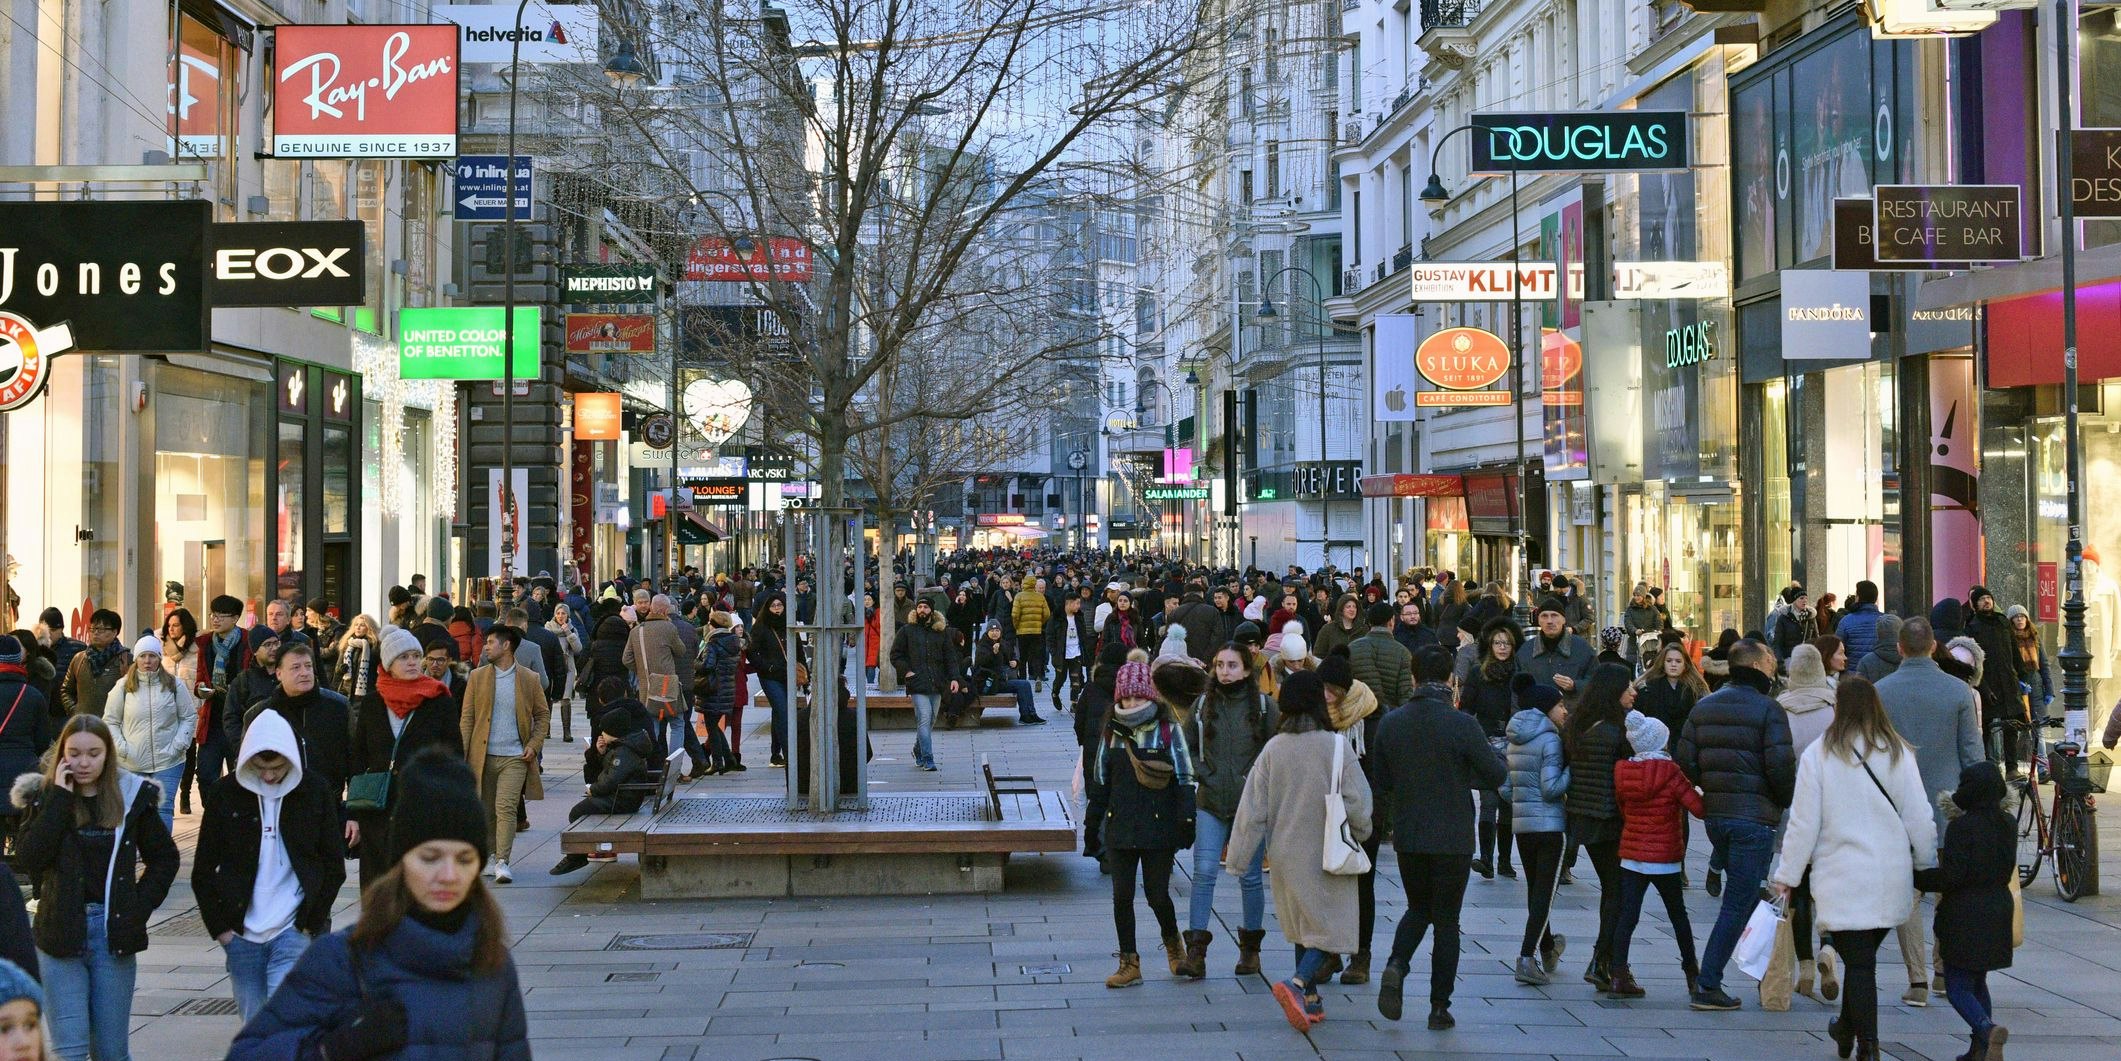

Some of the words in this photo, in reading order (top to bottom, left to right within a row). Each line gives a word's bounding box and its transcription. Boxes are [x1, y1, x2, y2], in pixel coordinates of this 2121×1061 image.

[280, 143, 351, 153] GENUINE
[359, 143, 407, 153] SINCE
[414, 143, 451, 153] 1937
[1489, 123, 1668, 161] DOUGLAS
[1882, 200, 2014, 218] RESTAURANT
[1894, 227, 1947, 245] CAFE
[1963, 227, 2004, 245] BAR
[211, 247, 351, 280] EOX
[0, 248, 176, 306] Jones
[567, 277, 636, 291] MEPHISTO
[1414, 270, 1466, 281] GUSTAV
[1468, 269, 1555, 292] KLIMT
[1414, 283, 1454, 293] EXHIBITION
[1788, 305, 1864, 321] PANDORA
[404, 330, 456, 343] UNITED
[459, 329, 514, 343] COLOR
[1666, 320, 1709, 368] DOUGLAS
[404, 345, 423, 358] OF
[426, 345, 503, 358] BENETTON.
[1427, 356, 1499, 373] SLUKA
[1467, 374, 1485, 382] 1891
[1423, 394, 1446, 402] CAFÉ
[1449, 394, 1505, 402] CONDITOREI
[1654, 384, 1686, 430] MOSCHINO
[1145, 488, 1208, 499] SALAMANDER
[2040, 580, 2056, 597] SALE
